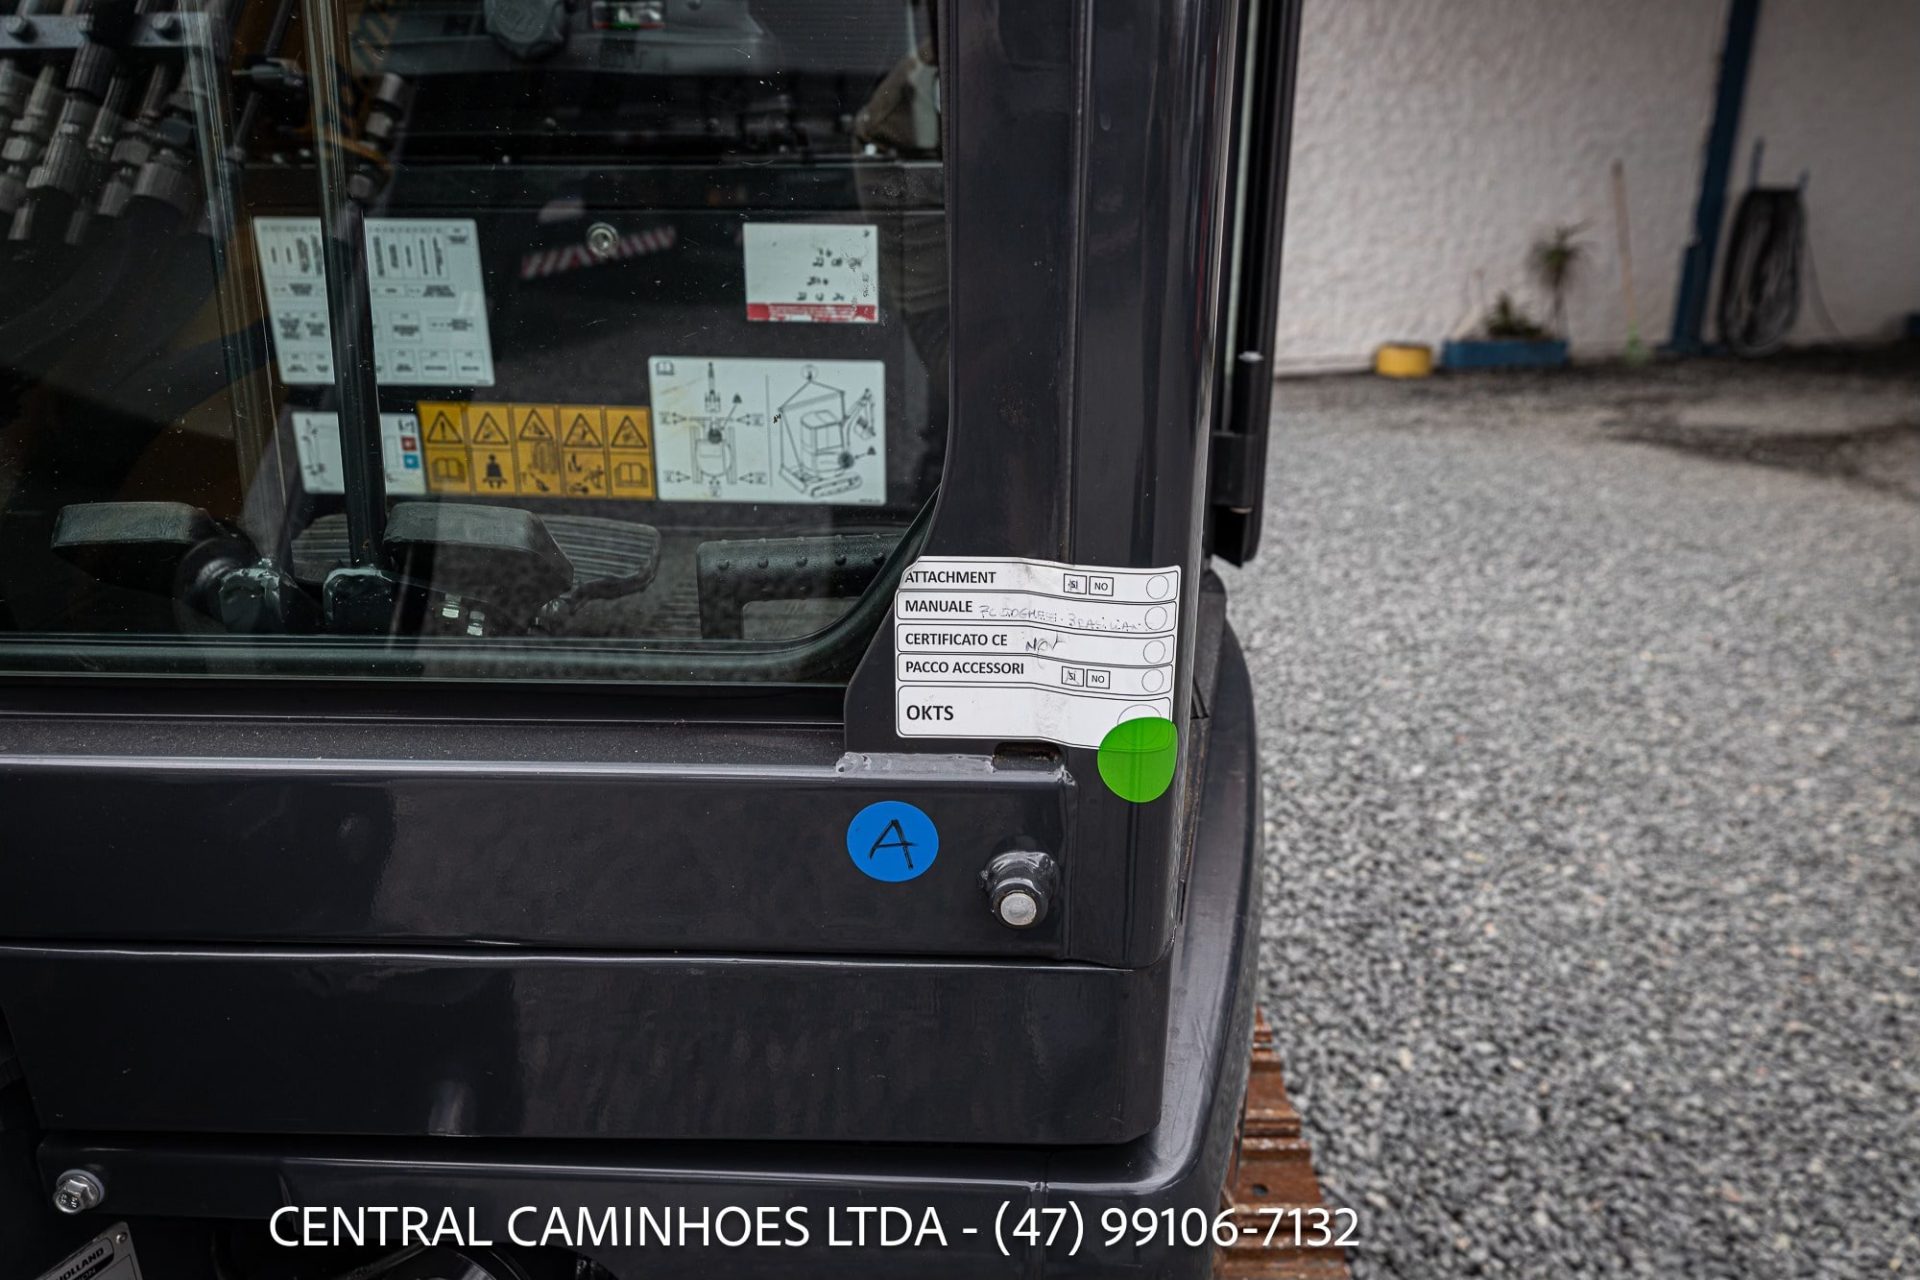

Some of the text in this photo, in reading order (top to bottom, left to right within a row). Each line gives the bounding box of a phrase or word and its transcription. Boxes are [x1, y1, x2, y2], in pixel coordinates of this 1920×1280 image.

[905, 570, 997, 584] ATTACHMENT
[1094, 582, 1109, 591] NO
[905, 599, 973, 613] MANUALE
[905, 633, 1008, 646] CERTIFICATO CE
[905, 661, 1024, 675] PACCO ACCESSORI
[1091, 674, 1105, 684] NO
[906, 705, 954, 721] OKTS
[868, 818, 917, 870] A
